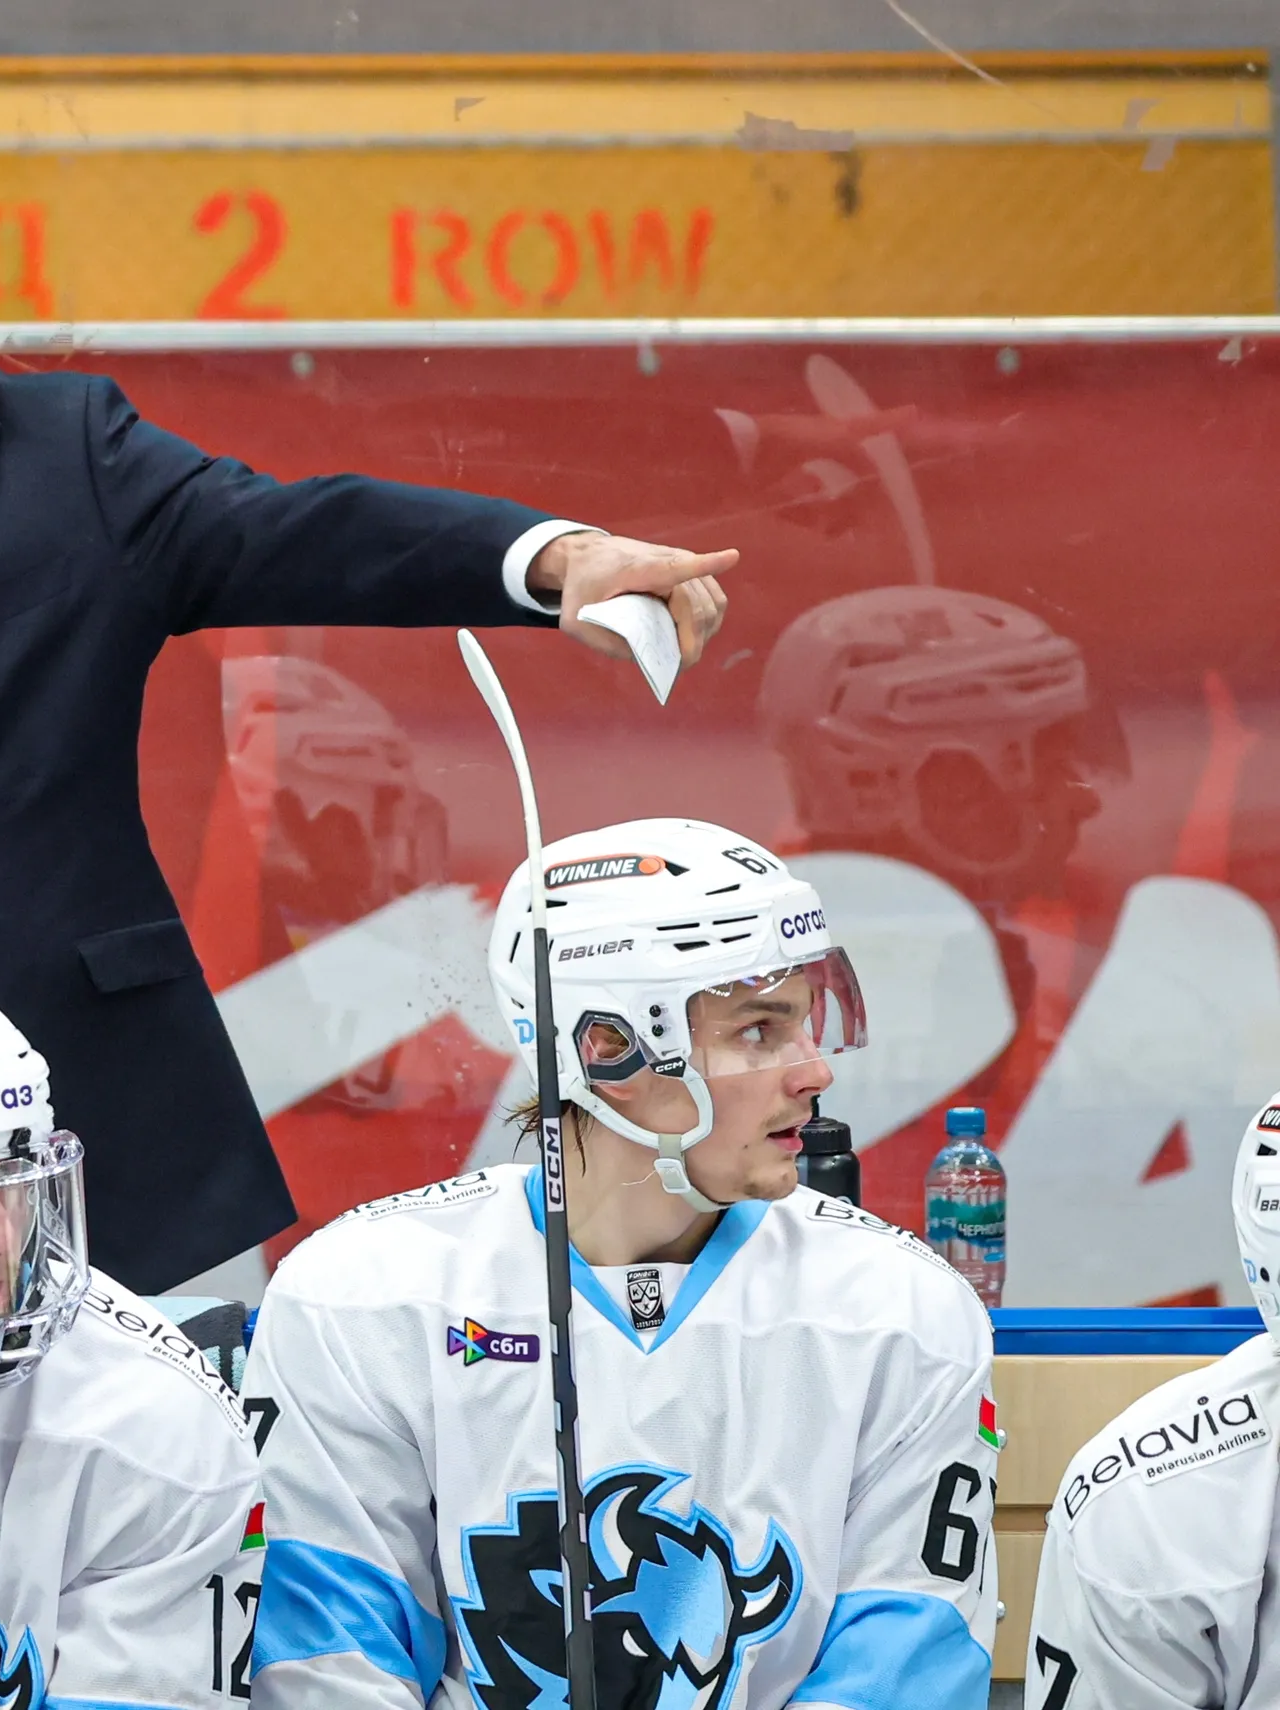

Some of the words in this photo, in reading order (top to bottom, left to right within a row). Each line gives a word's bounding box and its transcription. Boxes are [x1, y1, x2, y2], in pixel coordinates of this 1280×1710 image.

[193, 187, 289, 321] 2
[388, 207, 715, 310] ROW
[549, 857, 637, 885] WINLINE
[654, 1060, 685, 1075] CCM
[443, 1183, 492, 1204] Airlines
[545, 1124, 562, 1205] CCM
[1063, 1393, 1258, 1521] Belavia
[1146, 1449, 1215, 1479] Belarusian
[1217, 1426, 1267, 1455] Airlines
[920, 1460, 998, 1597] 6
[206, 1573, 261, 1700] 12
[1035, 1635, 1079, 1710] 7
